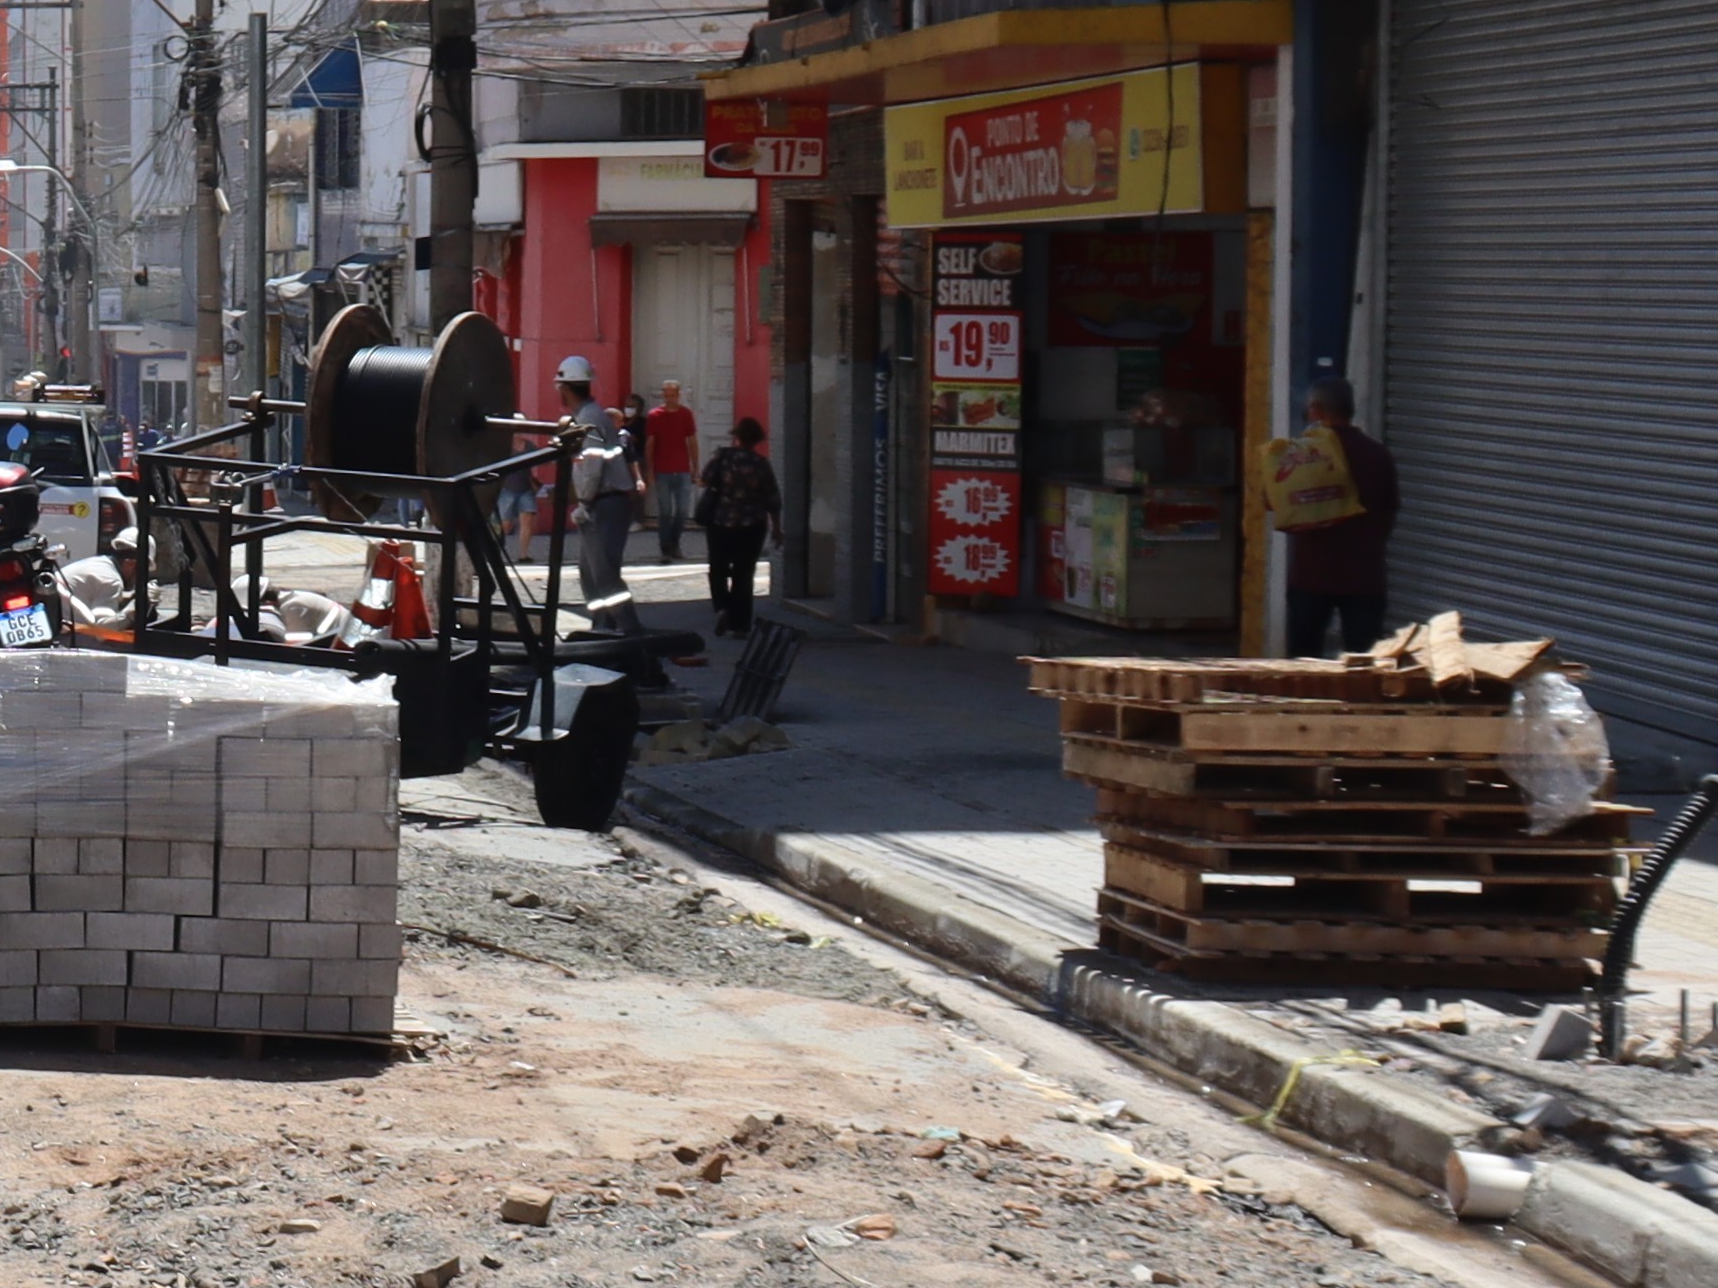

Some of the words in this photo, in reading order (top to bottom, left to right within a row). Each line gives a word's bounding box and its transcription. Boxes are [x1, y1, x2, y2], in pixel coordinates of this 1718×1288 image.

[986, 115, 1023, 148] PONTO
[1024, 111, 1040, 142] DE
[970, 145, 1060, 205] ENCONTRO
[937, 247, 978, 275] SELF
[937, 279, 1012, 306] SERVICE
[875, 371, 888, 411] VISA
[8, 614, 37, 630] GCE
